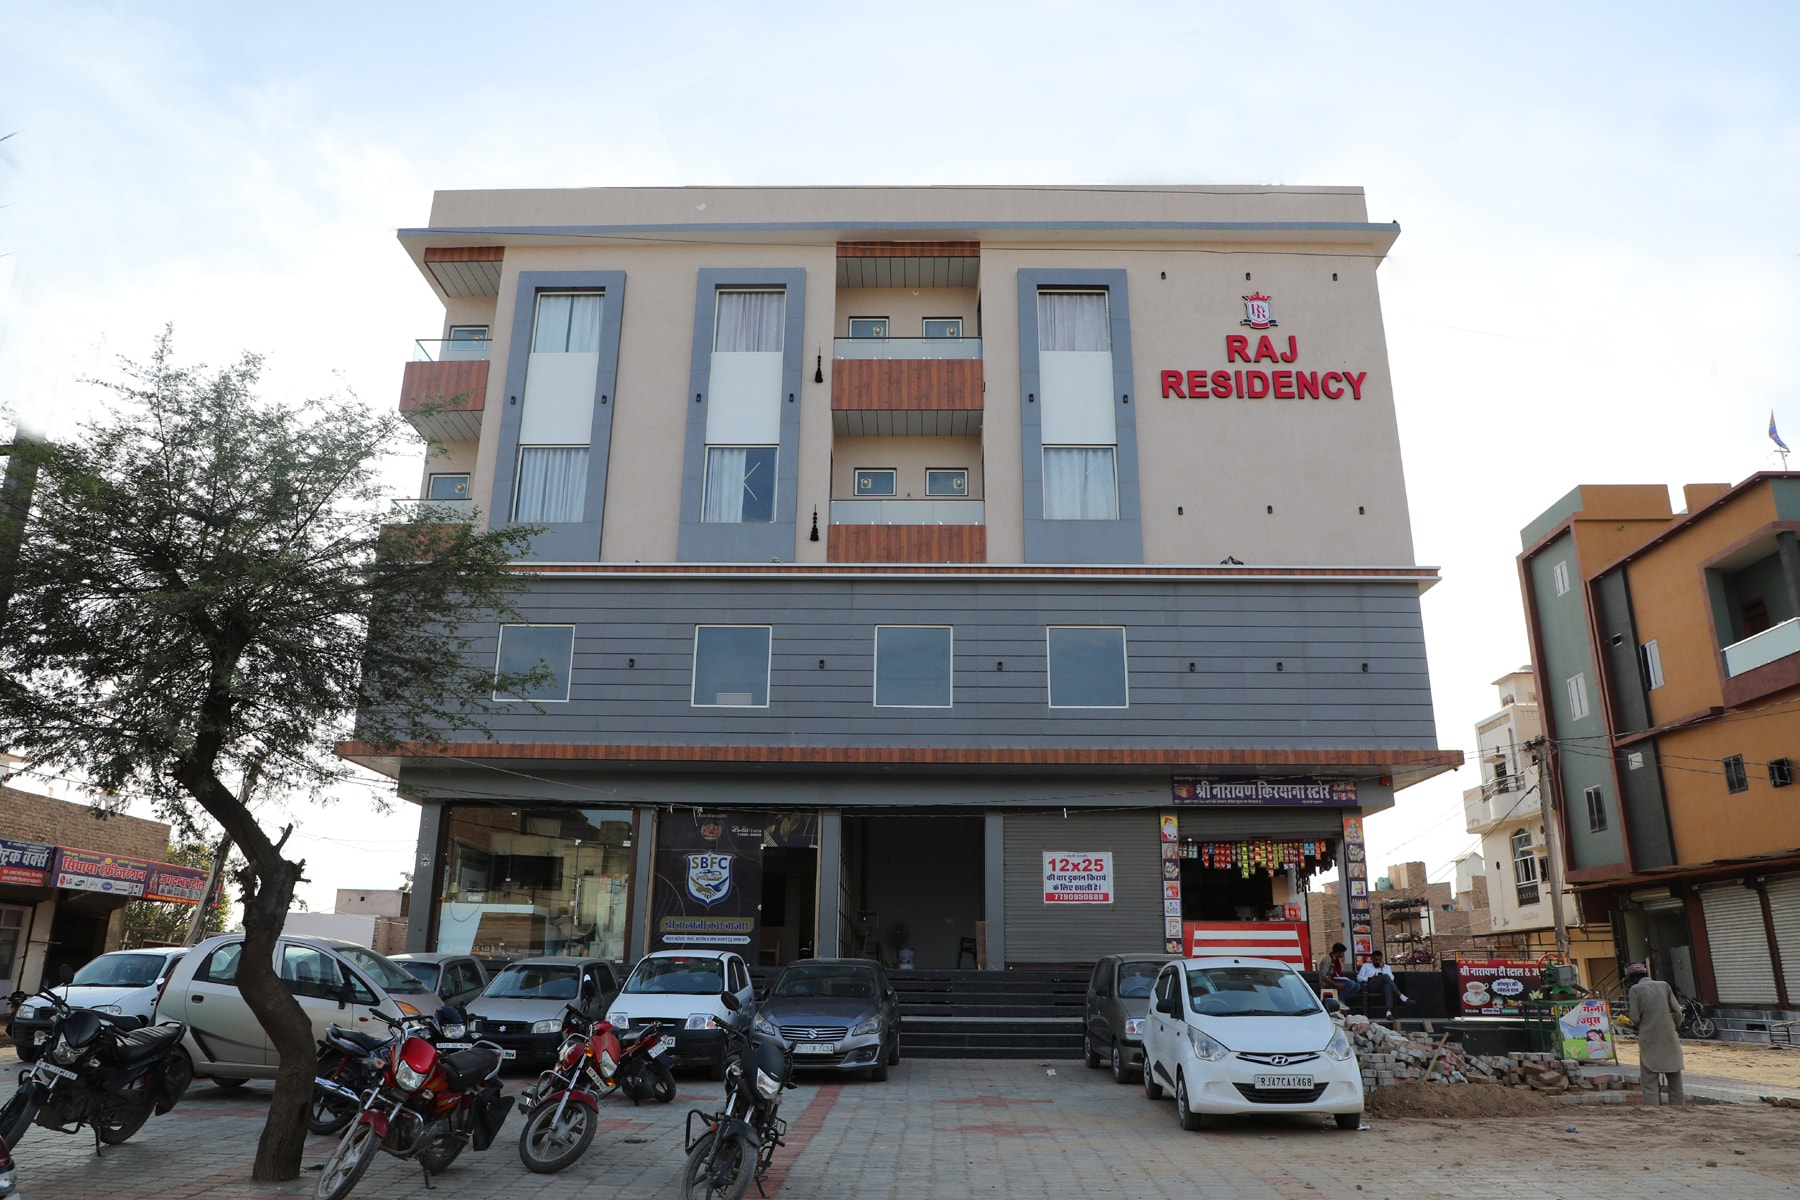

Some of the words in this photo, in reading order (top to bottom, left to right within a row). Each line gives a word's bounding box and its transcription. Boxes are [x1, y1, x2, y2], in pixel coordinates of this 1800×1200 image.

[1226, 335, 1298, 363] RAJ
[1161, 370, 1367, 399] RESIDENCY
[1196, 781, 1210, 798] श्री
[1212, 784, 1256, 799] नारायण
[1306, 781, 1330, 799] स्टोर
[691, 856, 728, 870] SBFC
[1048, 858, 1104, 872] 12x25
[1459, 966, 1470, 976] श्री
[1470, 968, 1497, 976] नारायण
[1260, 1077, 1312, 1087] RJ47CA1468
